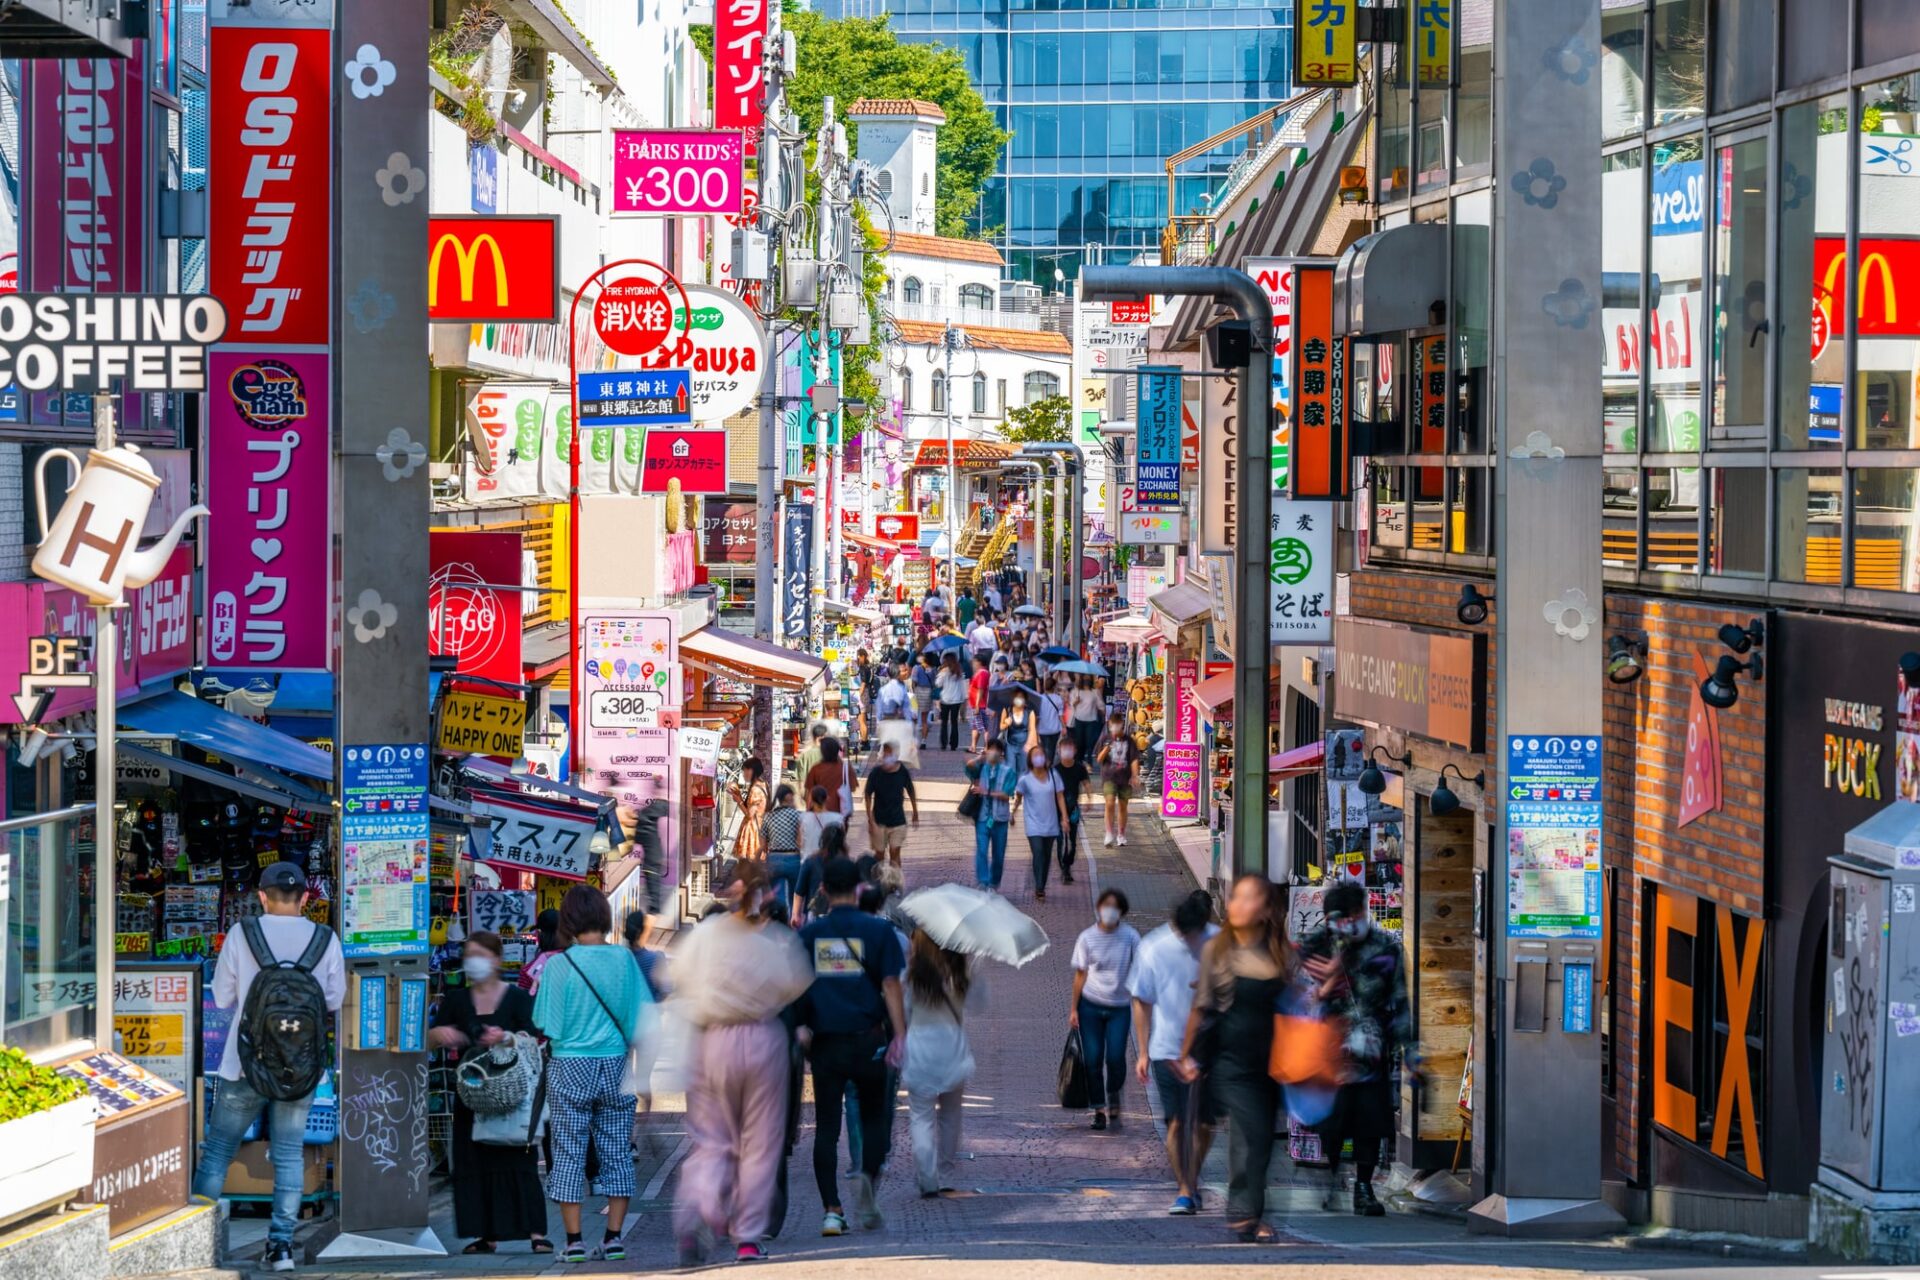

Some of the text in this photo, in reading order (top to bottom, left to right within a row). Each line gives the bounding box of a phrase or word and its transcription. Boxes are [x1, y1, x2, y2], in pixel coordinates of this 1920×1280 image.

[1305, 62, 1350, 80] 3F
[628, 137, 730, 161] PARIS KID'S
[239, 42, 302, 333] OSドラッグ
[626, 166, 729, 208] ¥300
[606, 286, 659, 296] FIRE HYDRANT
[0, 297, 226, 343] OSHINO
[600, 300, 667, 332] 消火栓
[676, 336, 756, 376] Pausa
[231, 368, 297, 403] egg
[600, 380, 668, 396] 東郷神社
[1304, 336, 1327, 427] 吉野家
[249, 400, 306, 416] nam
[600, 399, 673, 416] 東郷記念館
[674, 445, 687, 455] 6F
[1138, 480, 1179, 491] EXCHANGE
[1139, 466, 1178, 479] MONEY
[59, 500, 135, 585] H
[215, 603, 235, 619] B1
[1275, 593, 1325, 618] そば
[218, 621, 230, 633] F
[31, 639, 78, 675] BF
[1340, 651, 1396, 699] WOLFGANG
[1396, 661, 1425, 705] PUCK
[446, 695, 523, 728] ハッピーワン
[1824, 697, 1884, 732] WOLFGANG
[443, 725, 521, 754] HAPPY ONE
[1823, 732, 1882, 801] PUCK
[157, 977, 187, 993] BF
[94, 1145, 181, 1202] HOSHINO COFFEE
